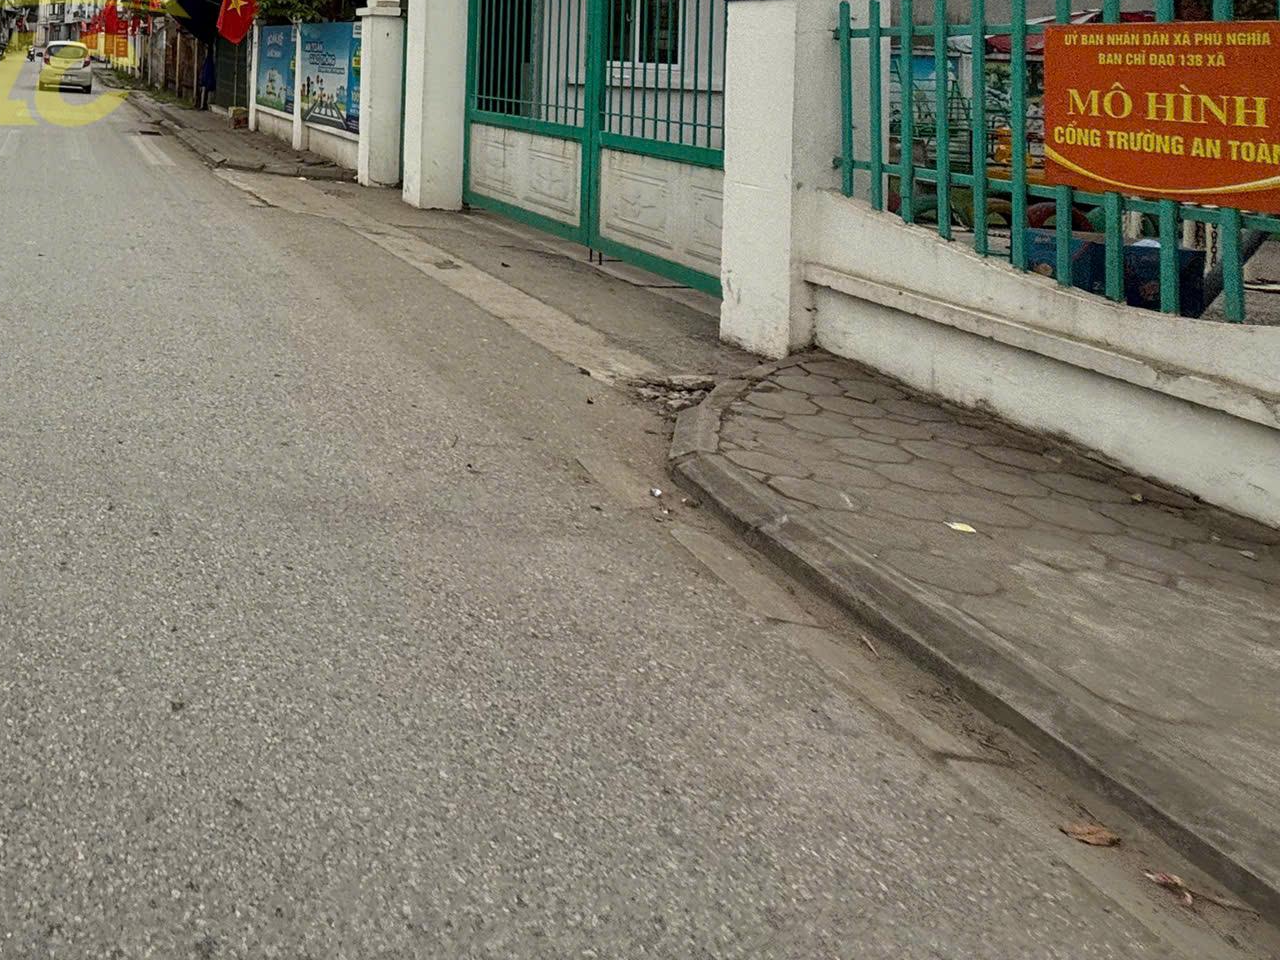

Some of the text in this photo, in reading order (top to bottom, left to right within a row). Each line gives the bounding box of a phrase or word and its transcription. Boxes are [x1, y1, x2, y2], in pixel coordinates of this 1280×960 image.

[1081, 33, 1104, 46] BAN
[1106, 31, 1139, 46] NHÂN
[1143, 31, 1169, 46] DÂN
[1173, 30, 1191, 46] XÃ
[1194, 30, 1223, 46] PHÚ
[1226, 30, 1271, 46] NGHĨA
[1098, 52, 1122, 65] BAN
[1149, 53, 1175, 68] ĐẠO
[1207, 52, 1226, 67] XÃ
[1066, 81, 1270, 128] MÔ HÌNH
[1053, 120, 1101, 147] CỔNG
[1106, 128, 1185, 156] TRƯỜNG
[1191, 137, 1221, 159] AN
